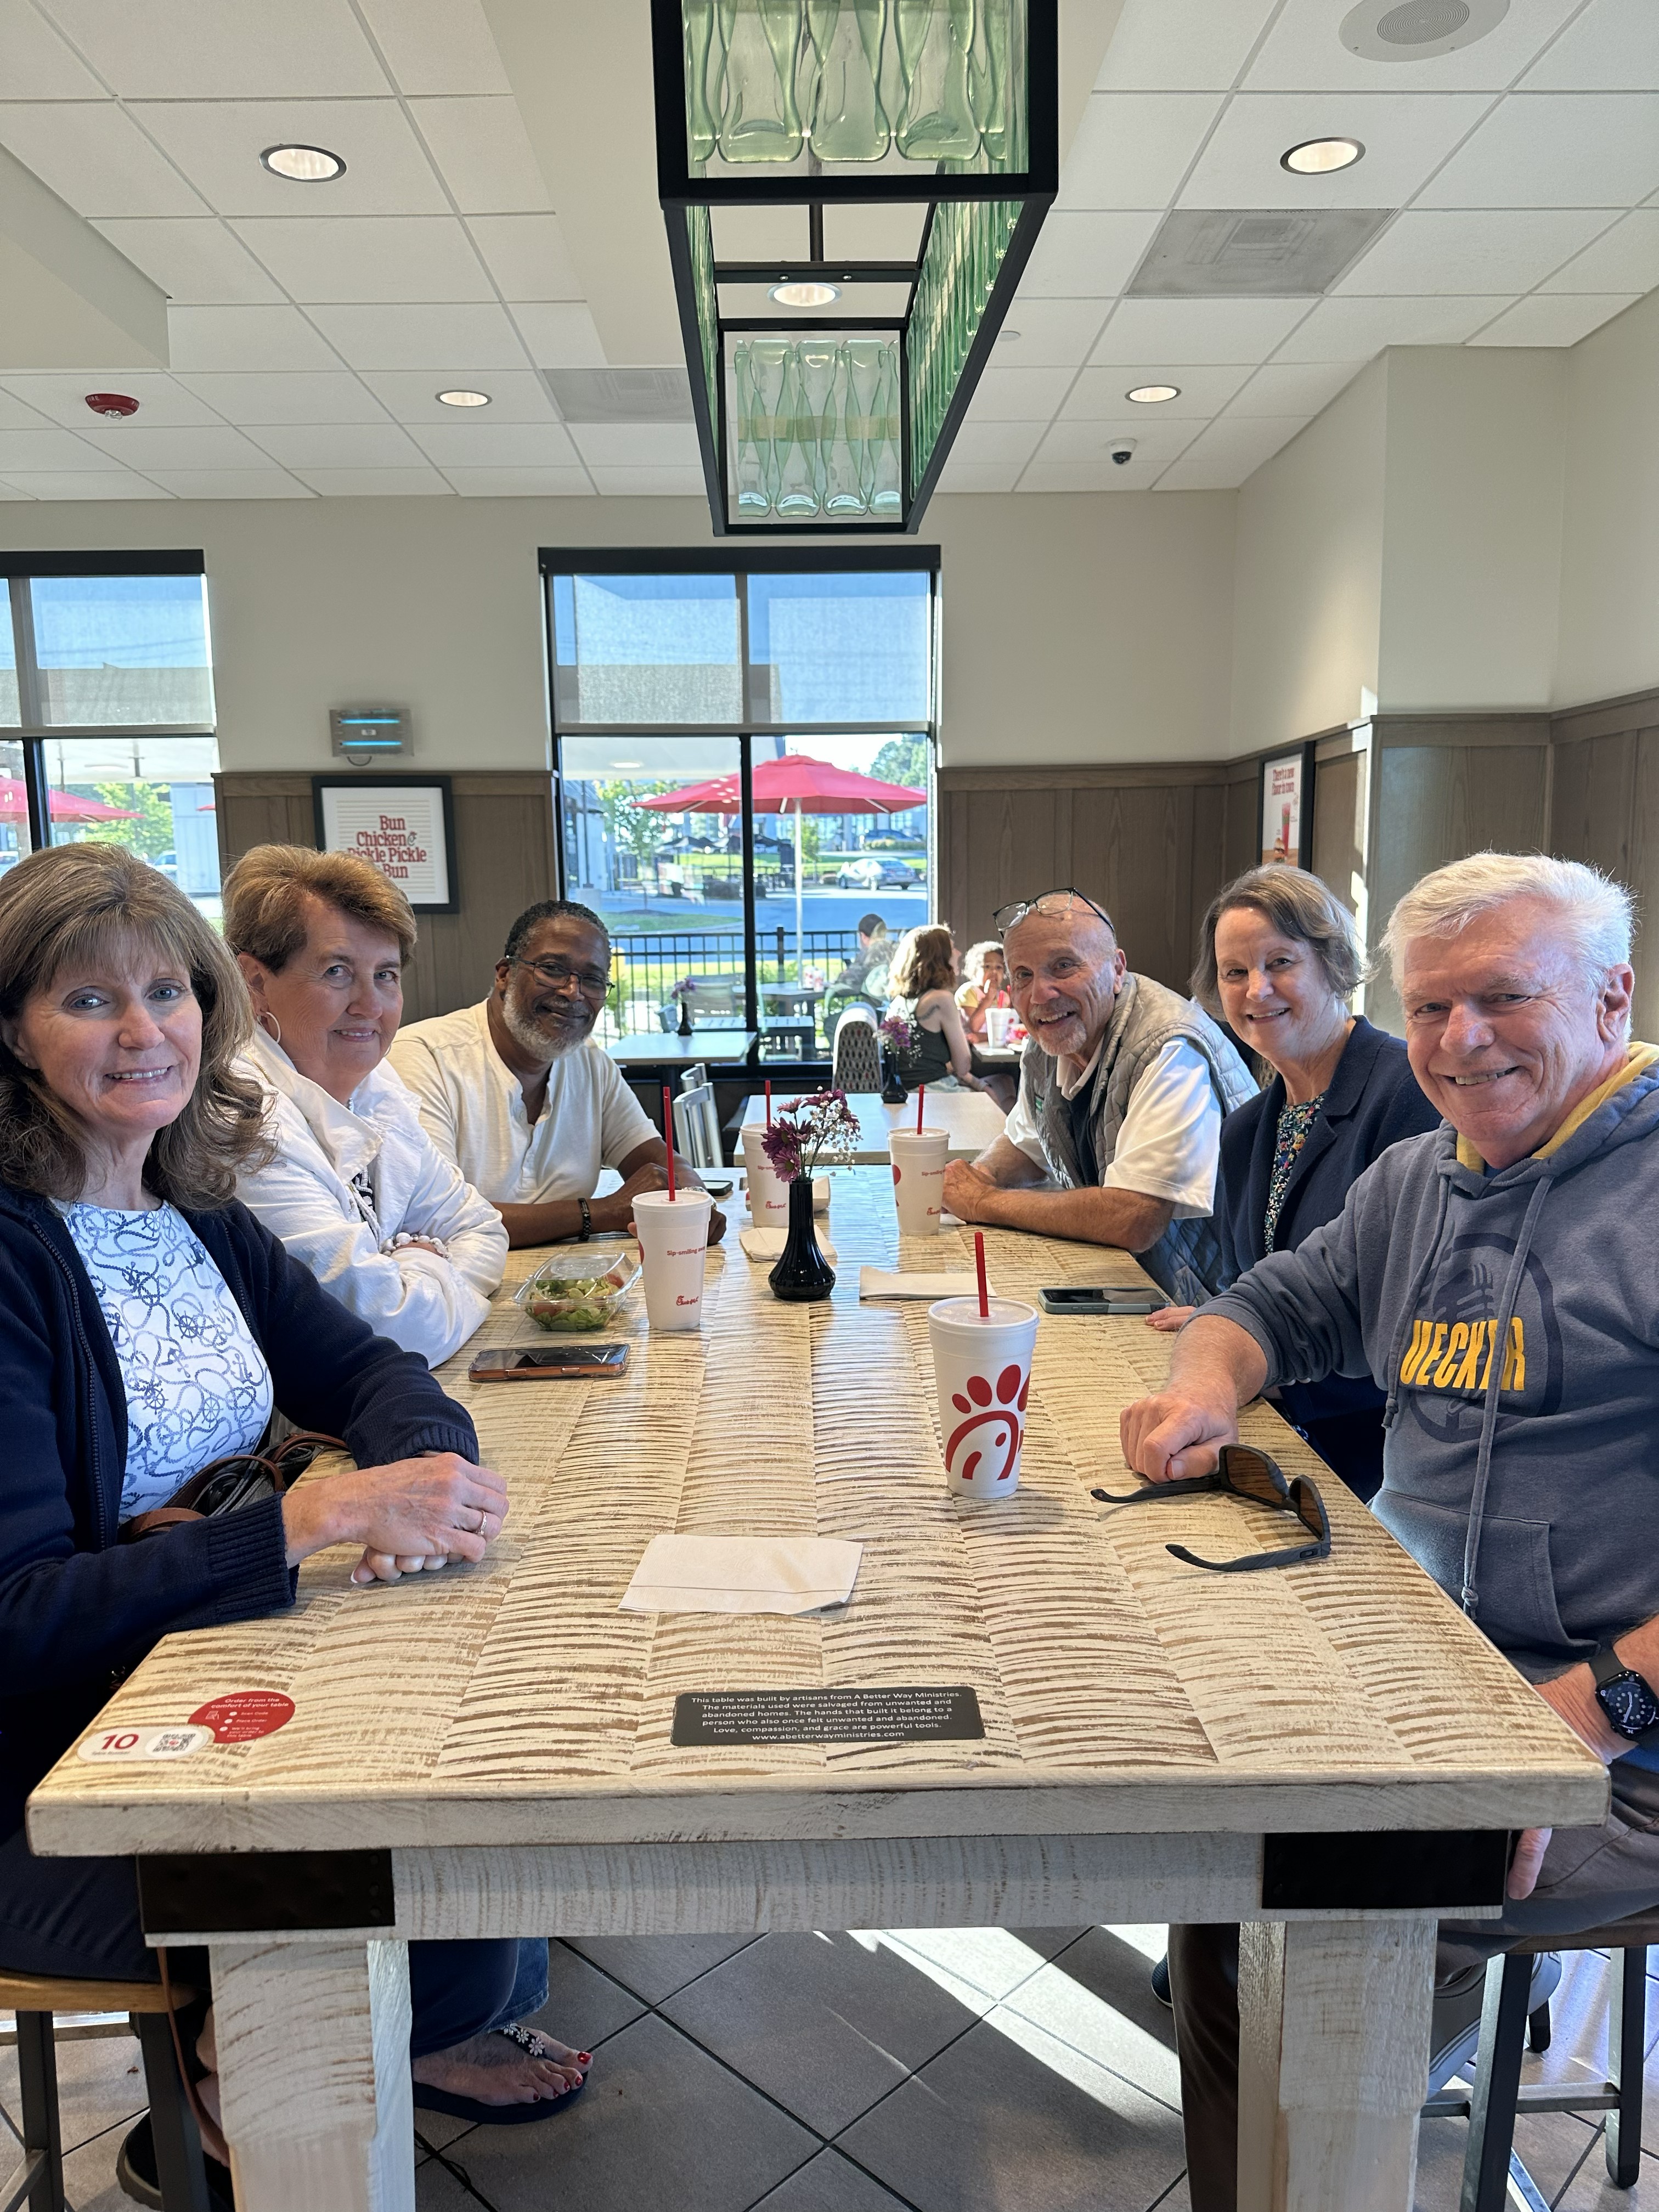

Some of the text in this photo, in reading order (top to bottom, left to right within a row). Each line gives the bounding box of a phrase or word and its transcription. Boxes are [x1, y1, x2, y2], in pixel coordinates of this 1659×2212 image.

[379, 815, 407, 831] Bun
[356, 831, 407, 847] Chicken
[387, 847, 427, 862] Pickle
[382, 864, 409, 879] Bun
[667, 1249, 697, 1257] Sip-smiling
[101, 1733, 139, 1750] 10
[752, 1731, 905, 1740] www.abetterwayministries.com
